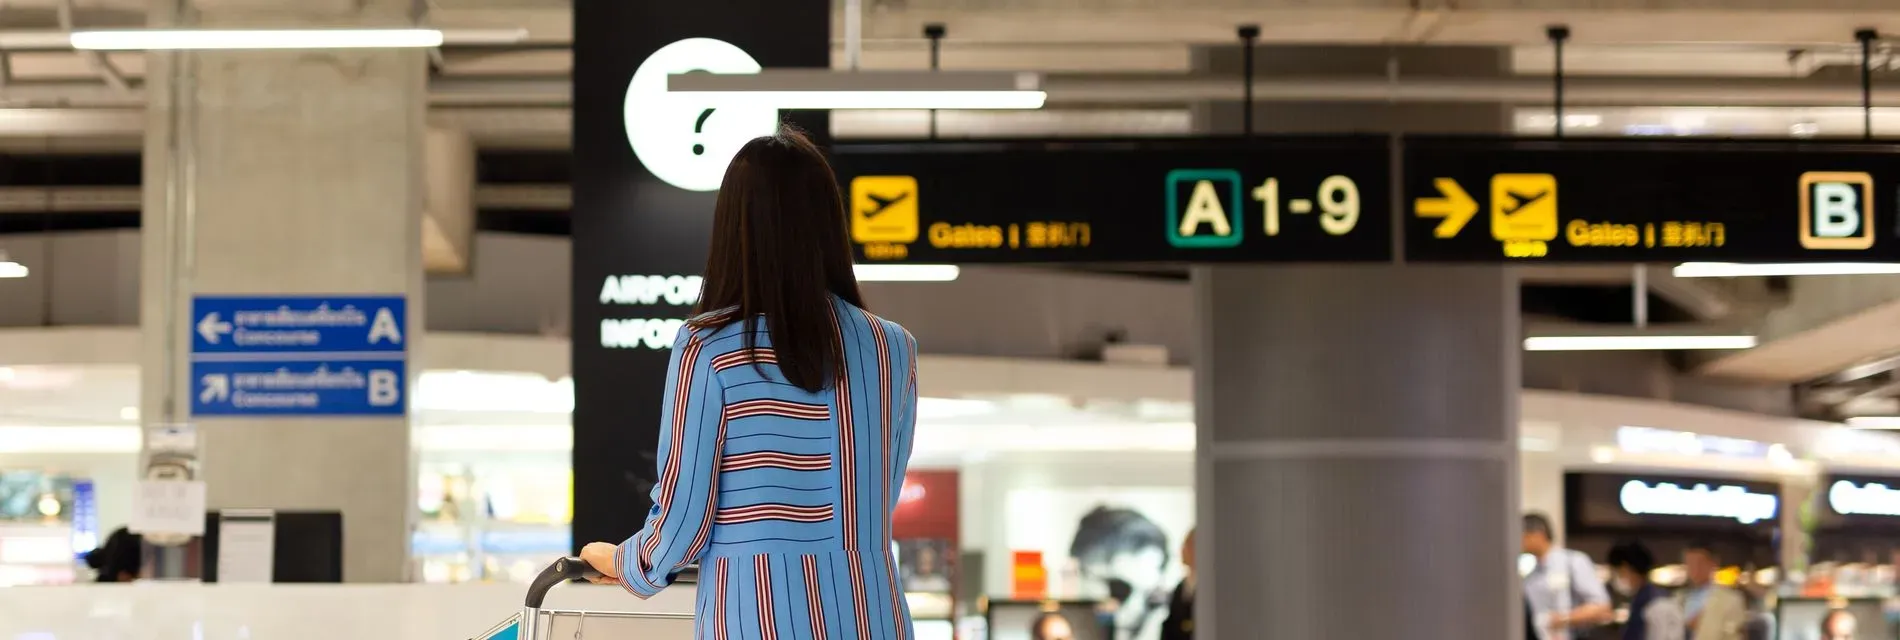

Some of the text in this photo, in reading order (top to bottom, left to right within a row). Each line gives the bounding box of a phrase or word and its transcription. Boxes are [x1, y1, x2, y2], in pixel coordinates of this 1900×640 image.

[1179, 175, 1360, 237] A 1-9
[1814, 183, 1859, 237] B
[928, 222, 1004, 248] Gates
[1566, 219, 1640, 247] Gates
[599, 274, 703, 305] AIRPOR
[367, 307, 402, 344] A
[368, 370, 399, 406] B
